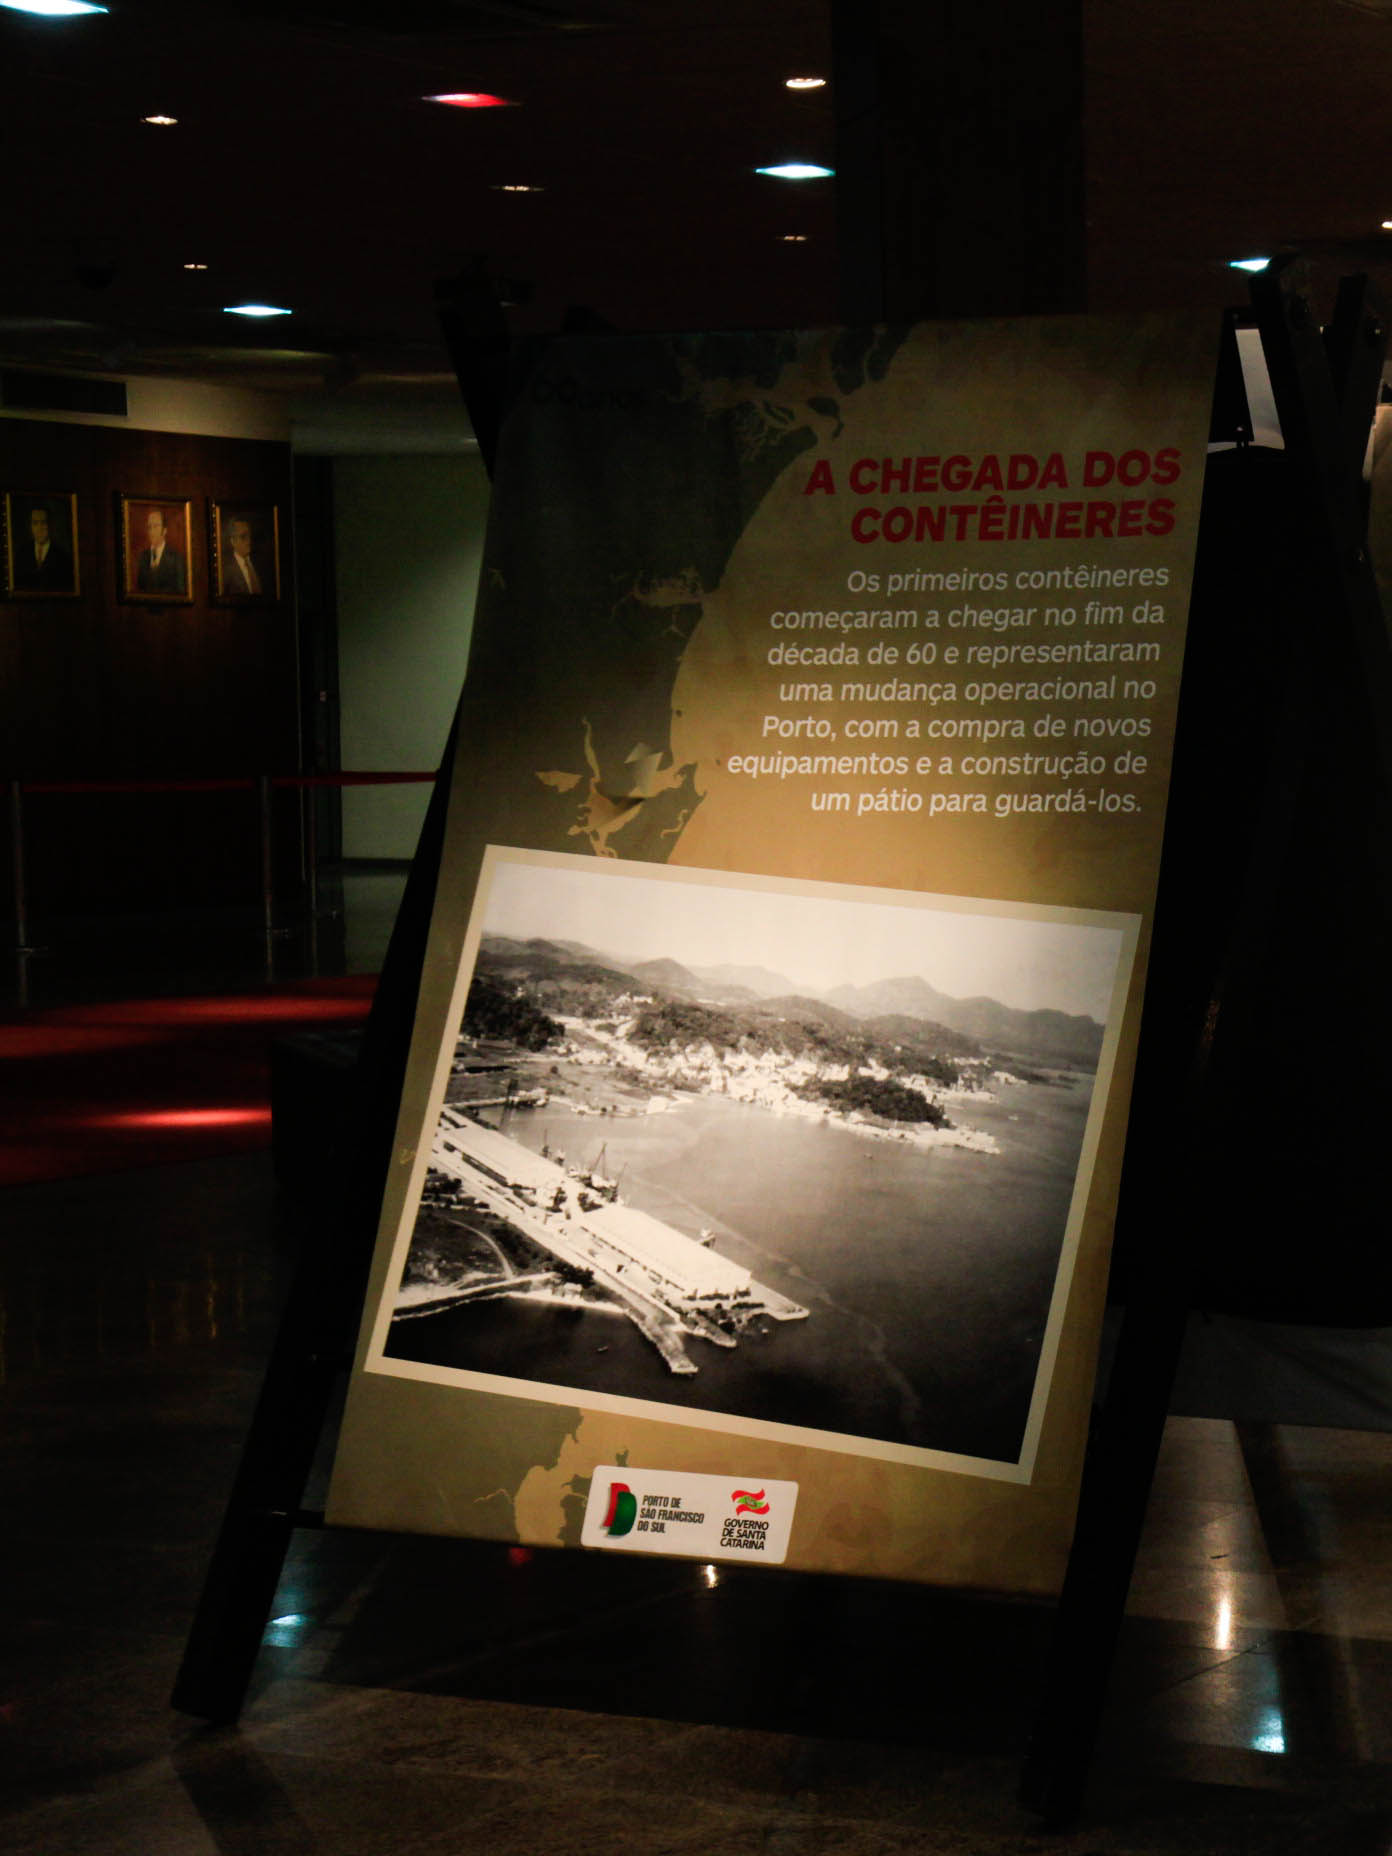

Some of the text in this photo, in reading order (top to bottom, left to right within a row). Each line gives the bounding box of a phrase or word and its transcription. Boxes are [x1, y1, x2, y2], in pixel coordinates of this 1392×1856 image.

[805, 448, 1182, 495] A CHEGADA DOS
[851, 496, 1176, 543] CONTÊINERES
[848, 566, 1169, 596] Os primeiros contêineres
[770, 601, 1165, 634] começaram a chegar no fim da
[767, 640, 1160, 667] década de 60 e representaram
[780, 676, 1156, 705] uma mudança operacional no
[762, 715, 1151, 743] Porto, com a compra de novos
[728, 751, 1147, 779] equipamentos e a construção de
[812, 788, 1141, 817] um pátio para guardá-los.
[658, 1510, 704, 1523] FRANCISCO
[724, 1518, 769, 1530] GOVERNO
[720, 1538, 764, 1550] CATARINA
[722, 1528, 766, 1540] DE SANTA
